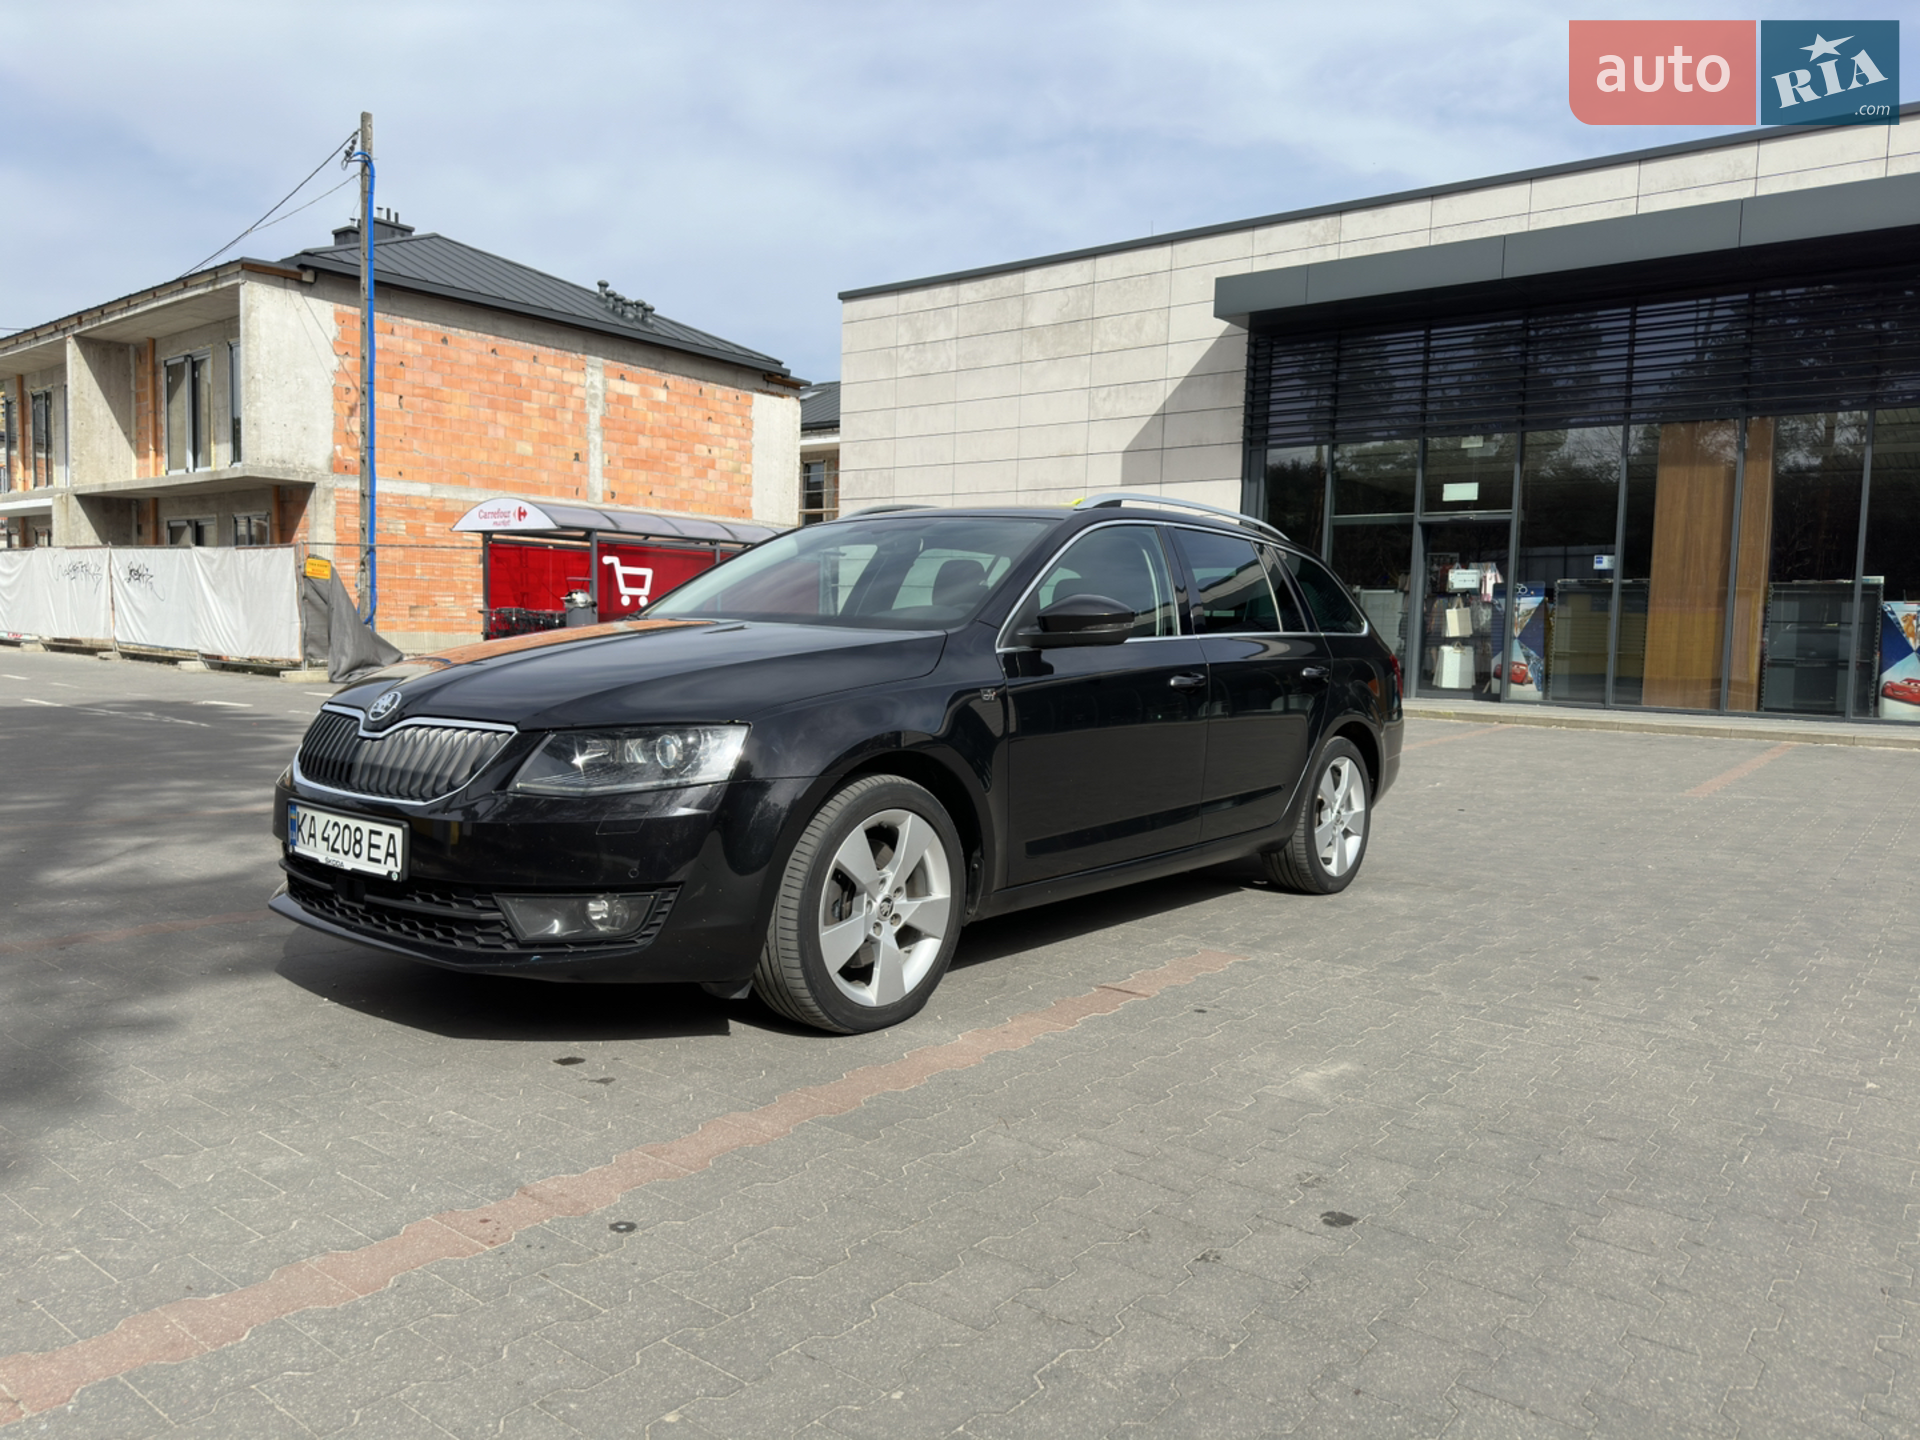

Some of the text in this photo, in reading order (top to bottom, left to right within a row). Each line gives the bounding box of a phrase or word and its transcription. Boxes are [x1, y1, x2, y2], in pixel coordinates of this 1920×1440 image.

[478, 508, 511, 520] Carrefour
[297, 811, 398, 868] KA 4208 EA
